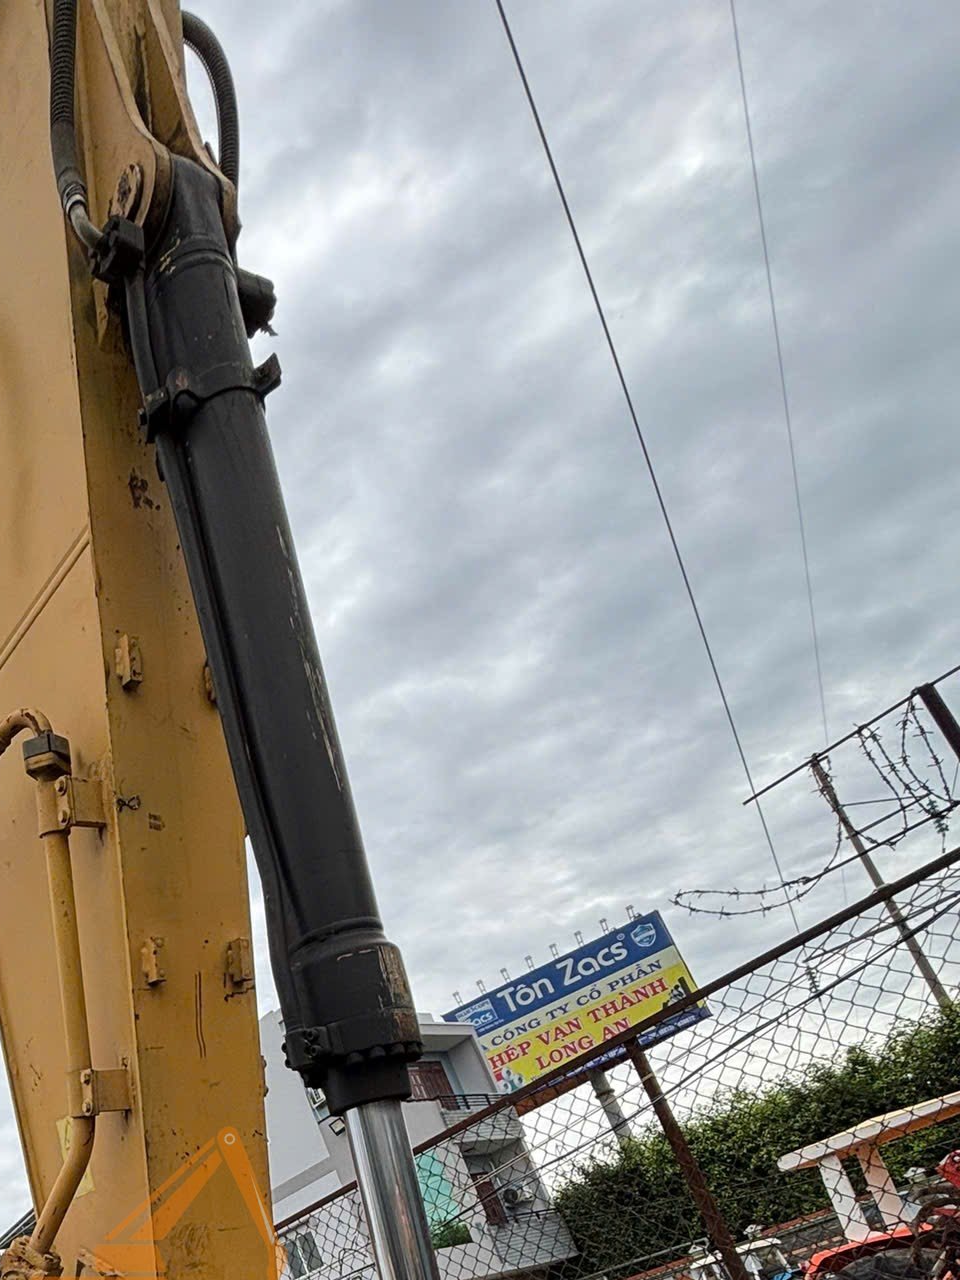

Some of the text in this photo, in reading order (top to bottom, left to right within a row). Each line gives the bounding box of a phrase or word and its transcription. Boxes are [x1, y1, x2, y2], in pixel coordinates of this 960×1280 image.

[491, 1018, 541, 1046] CÔNG
[545, 1003, 569, 1020] TY
[576, 983, 601, 1006] CỔ
[607, 959, 663, 993] PHẦN
[496, 941, 628, 1012] Tôn Zacs
[535, 1035, 594, 1070] LONG
[602, 1016, 630, 1042] AN
[536, 1017, 583, 1047] VẠN
[587, 977, 669, 1023] THÀNH
